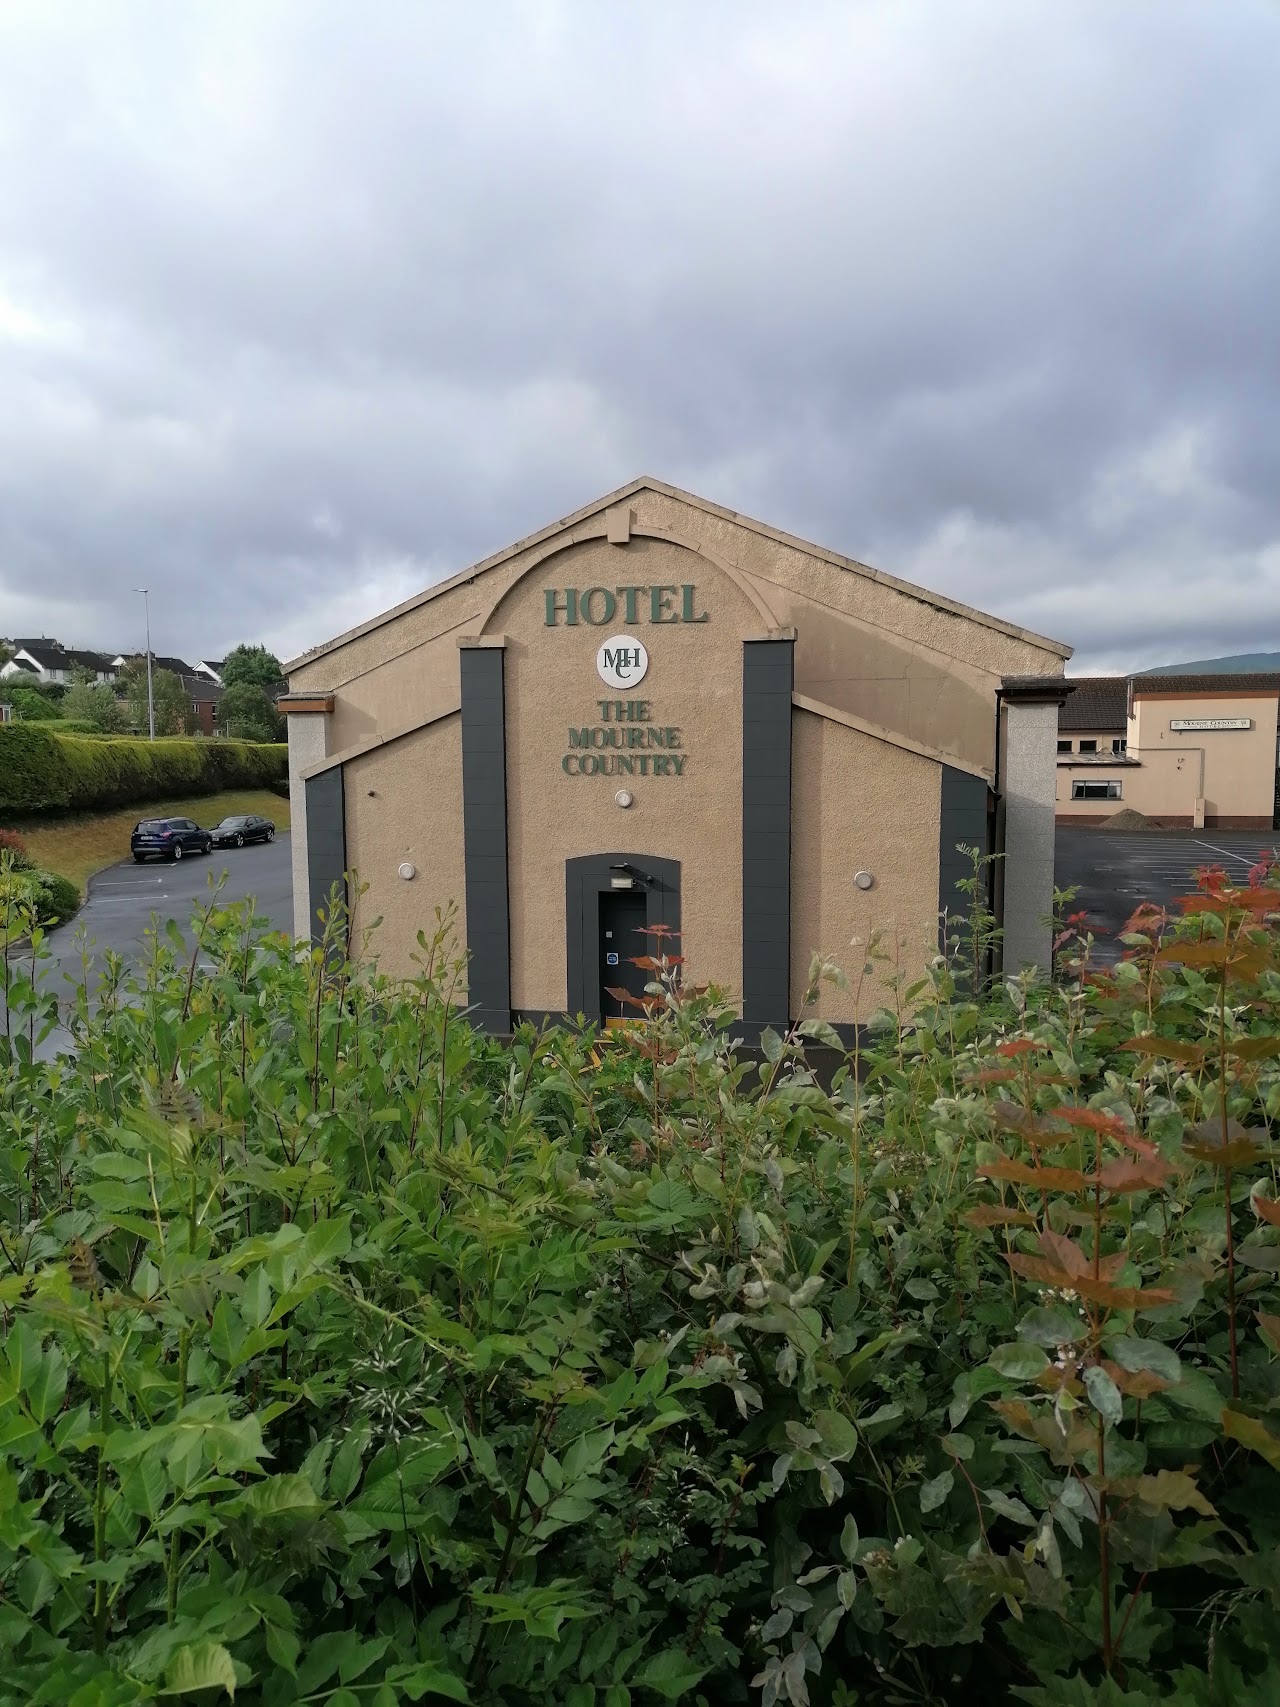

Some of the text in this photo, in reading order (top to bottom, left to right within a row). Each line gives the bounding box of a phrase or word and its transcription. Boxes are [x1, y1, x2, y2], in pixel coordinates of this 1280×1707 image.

[543, 584, 709, 626] HOTEL
[597, 700, 653, 722] THE
[568, 727, 682, 749] MOURNE
[561, 754, 688, 776] COUNTRY
